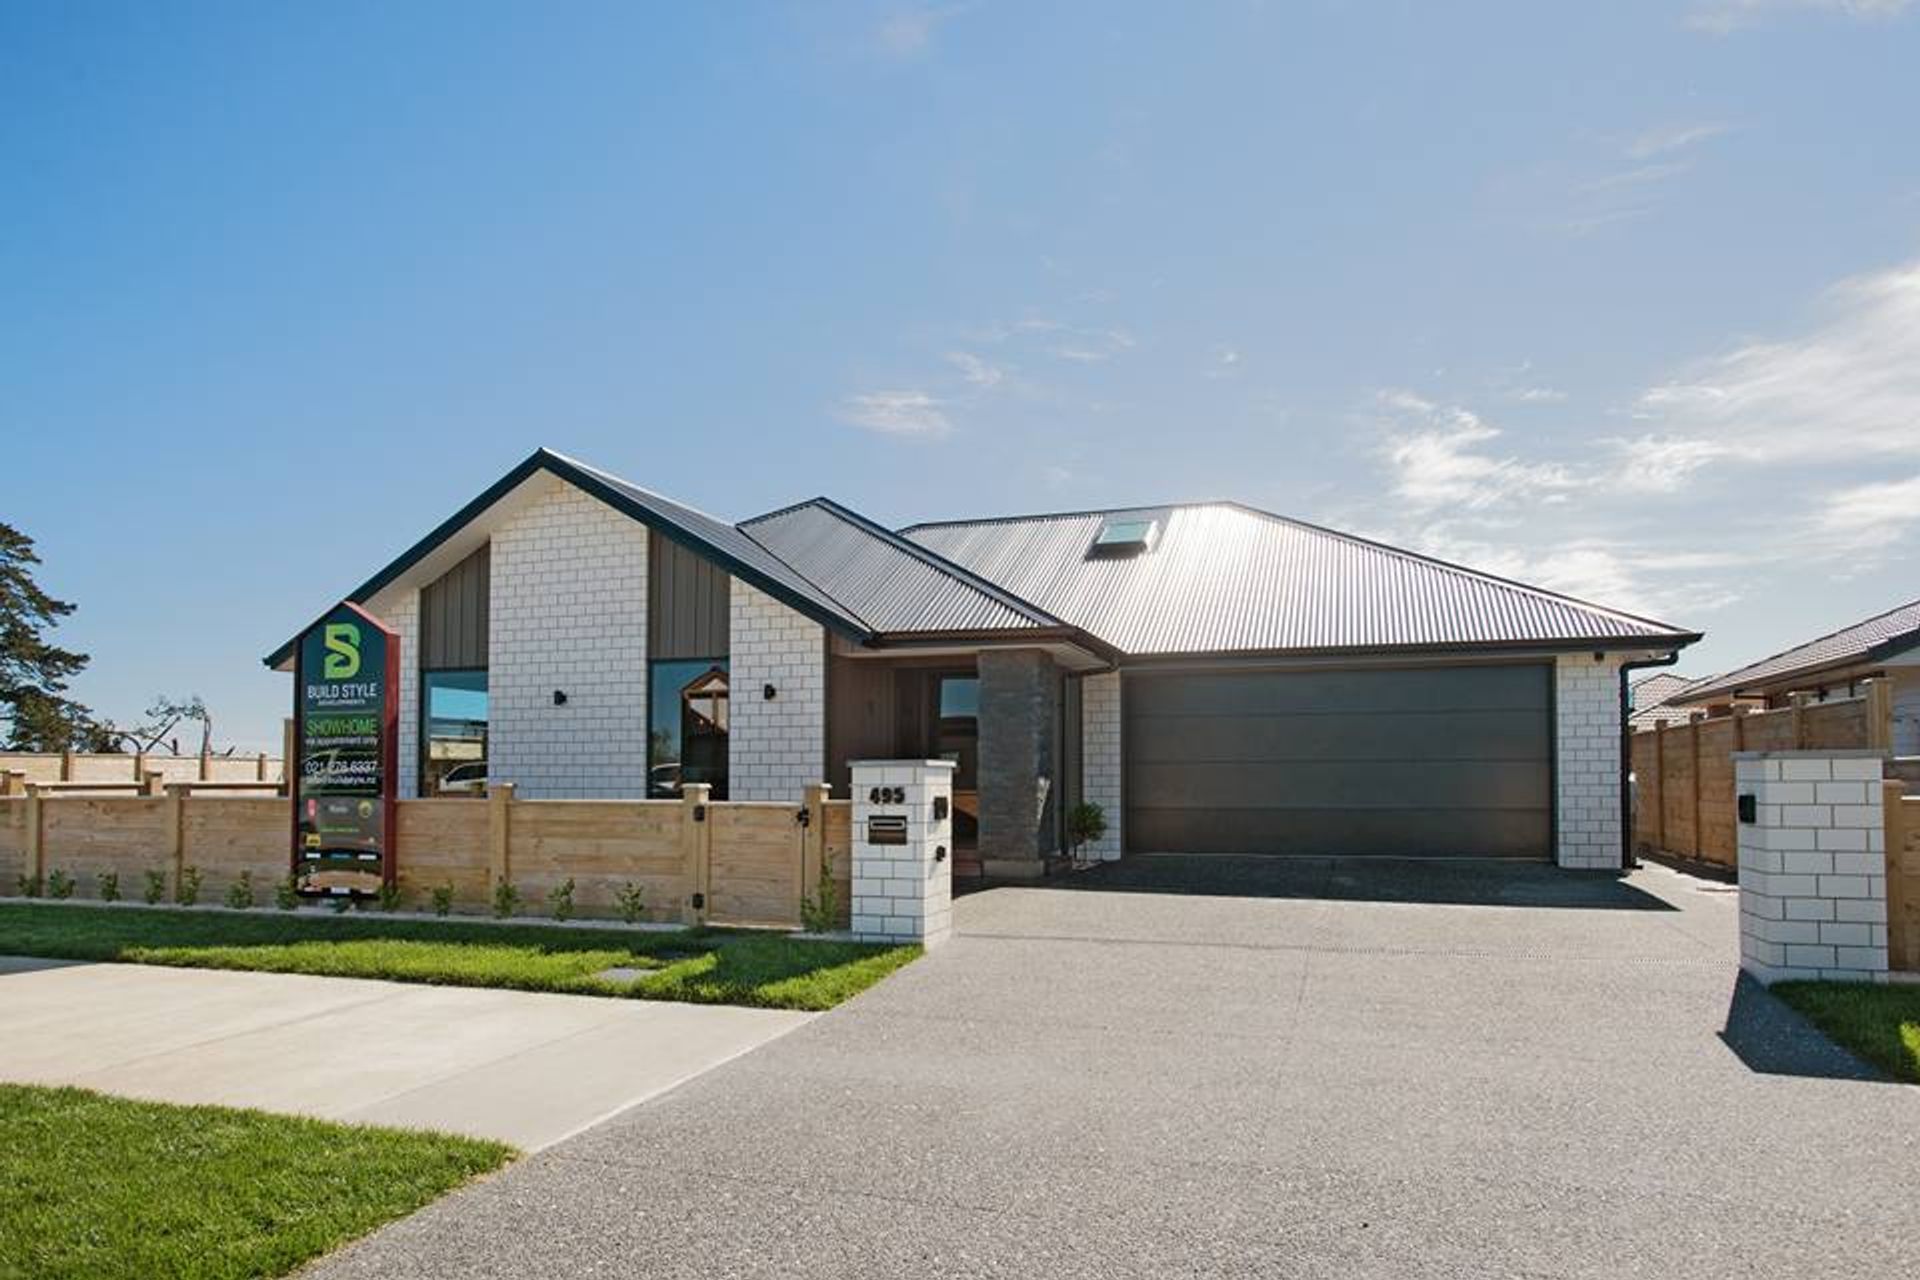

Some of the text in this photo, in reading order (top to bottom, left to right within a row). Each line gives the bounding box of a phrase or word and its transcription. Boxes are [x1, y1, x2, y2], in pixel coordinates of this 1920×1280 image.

[307, 683, 377, 699] BUILD STYLE
[306, 719, 378, 736] SHOWHOME
[870, 787, 905, 804] 495
